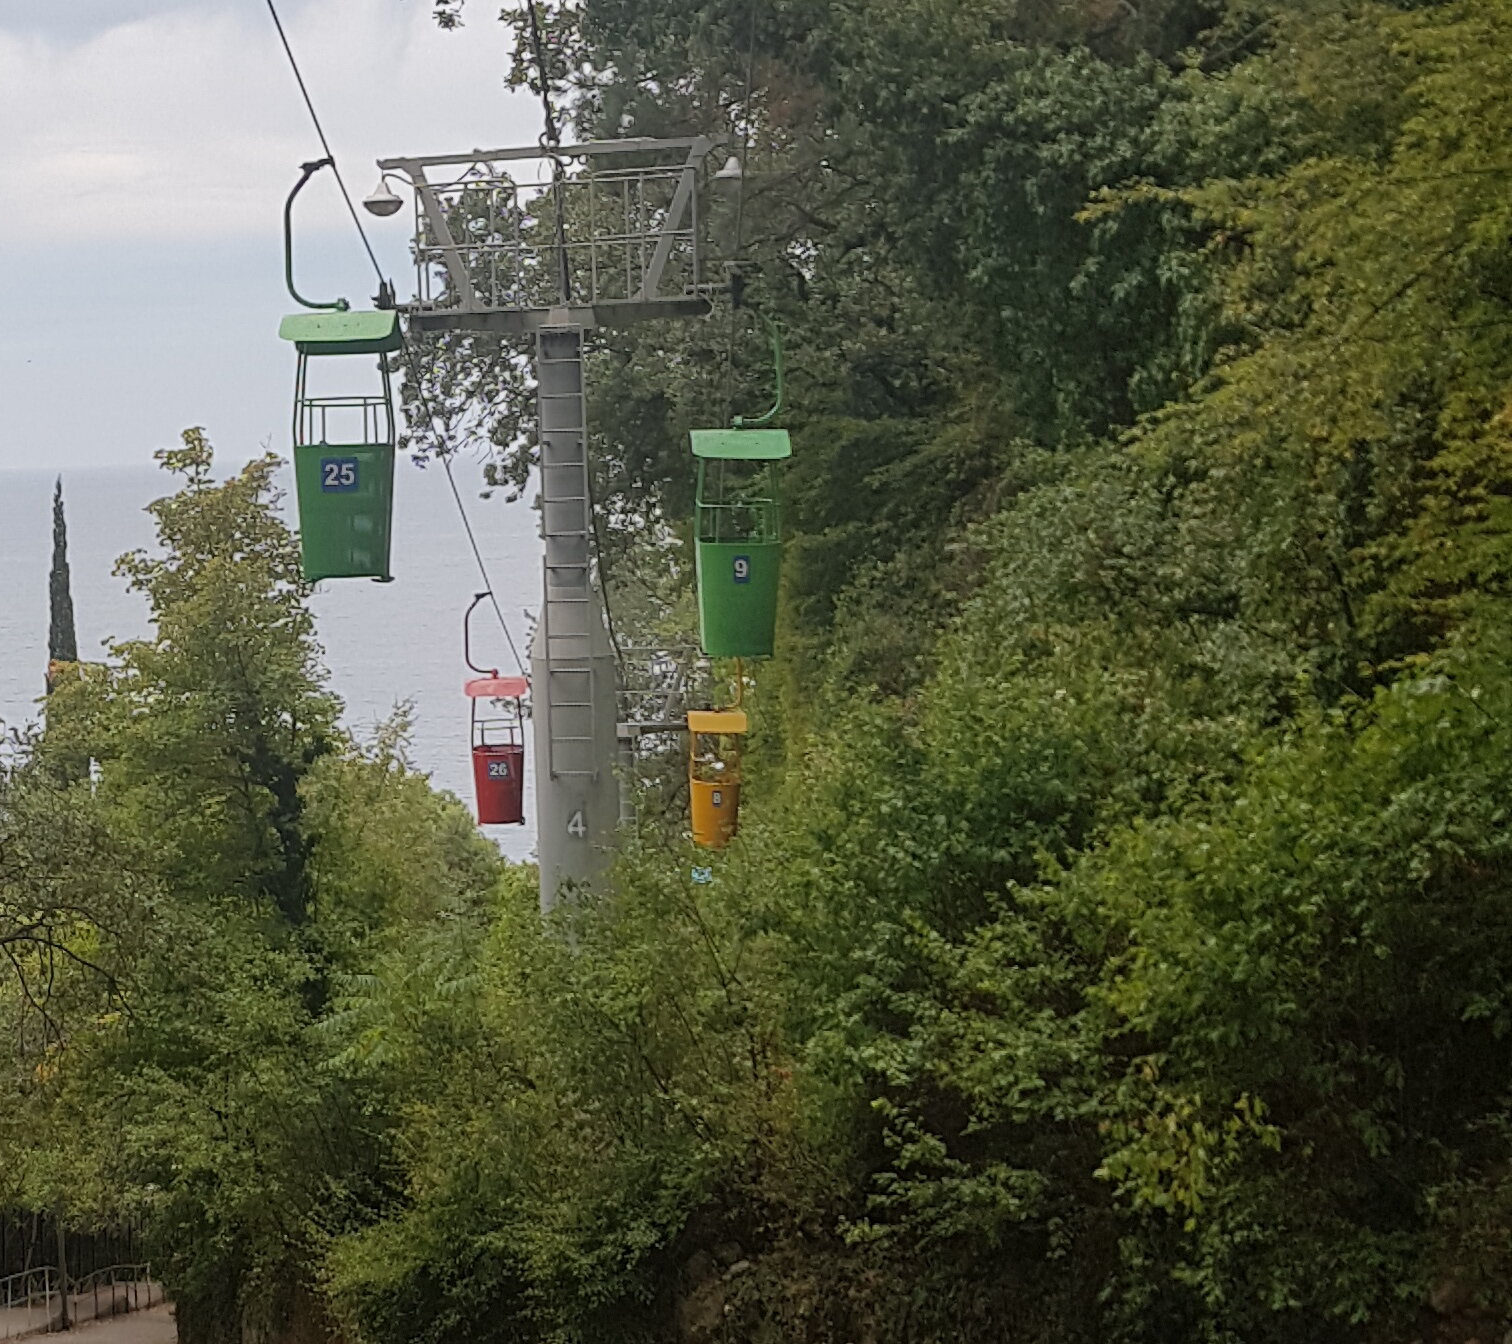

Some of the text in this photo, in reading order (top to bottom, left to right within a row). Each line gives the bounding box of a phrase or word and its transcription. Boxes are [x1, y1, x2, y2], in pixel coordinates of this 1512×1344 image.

[324, 463, 355, 486] 25
[734, 559, 748, 578] 9
[489, 762, 508, 776] 26
[567, 810, 587, 838] 4
